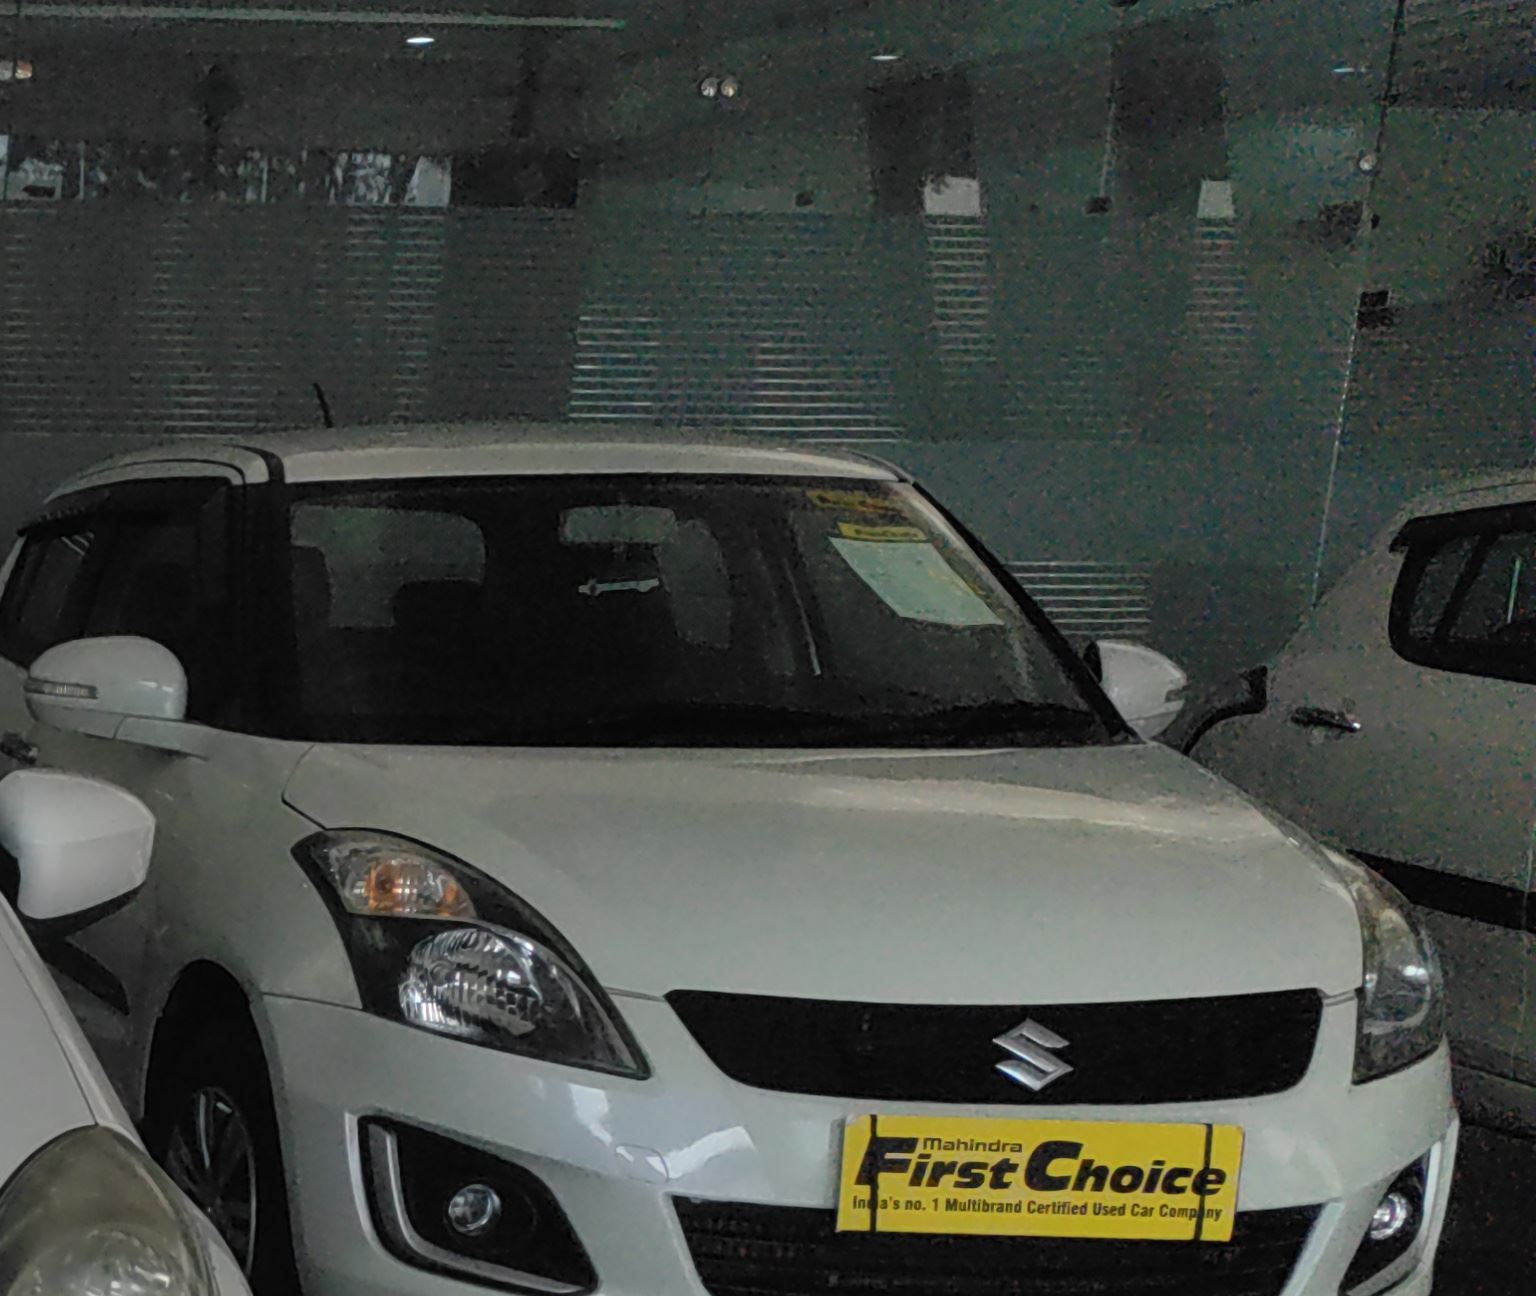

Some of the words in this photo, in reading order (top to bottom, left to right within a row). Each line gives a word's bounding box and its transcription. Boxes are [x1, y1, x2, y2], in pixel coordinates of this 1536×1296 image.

[923, 1137, 1023, 1153] Mahindra
[854, 1136, 1020, 1190] First
[1024, 1140, 1227, 1196] Choice
[945, 1197, 1022, 1214] Multibrand
[1027, 1200, 1088, 1216] Certified
[1093, 1202, 1126, 1216] Used
[1130, 1203, 1155, 1218] Car
[1159, 1204, 1223, 1222] Compny
